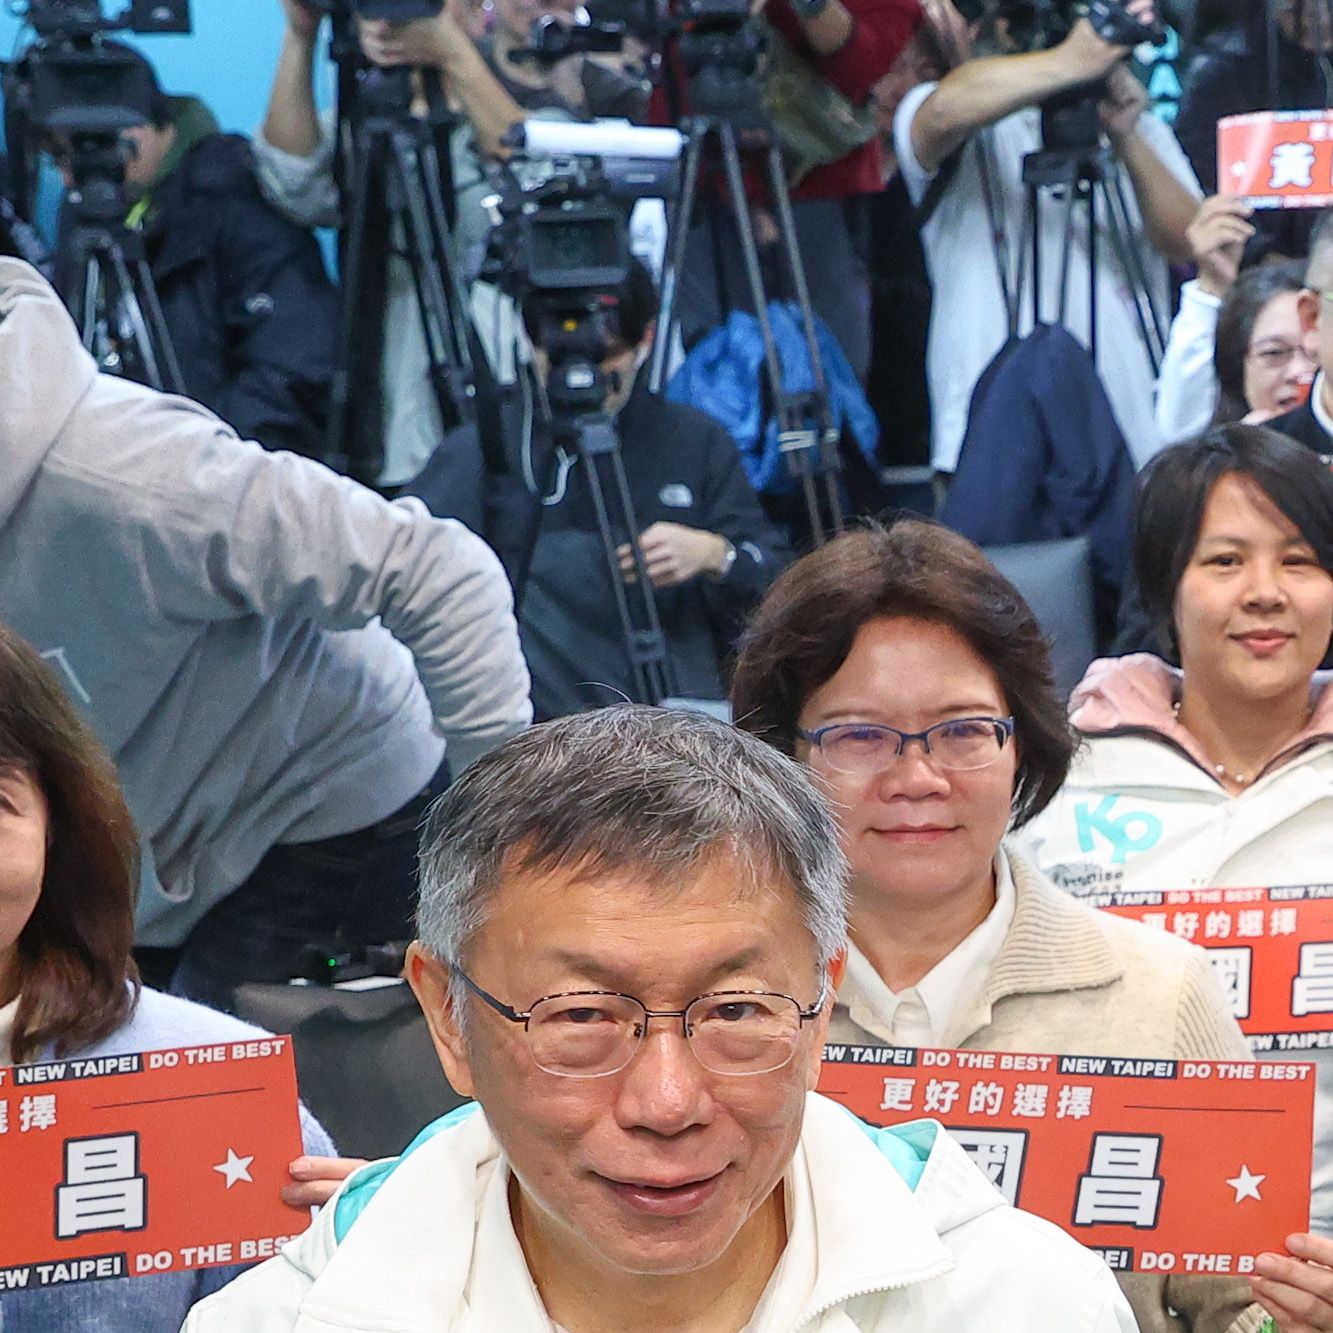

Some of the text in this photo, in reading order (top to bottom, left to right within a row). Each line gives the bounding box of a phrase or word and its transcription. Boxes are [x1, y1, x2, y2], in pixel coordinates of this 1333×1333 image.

[18, 1039, 285, 1084] NEW TAIPEI DO THE BEST
[850, 1047, 1310, 1080] TAIPEI DO THE BEST NEW TAIPEI DO THE BEST
[880, 1077, 1094, 1121] 更好的選擇
[56, 1133, 146, 1238] 昌
[0, 1243, 232, 1290] EW TAIPEI DO THE
[1140, 1252, 1232, 1272] DO THE
